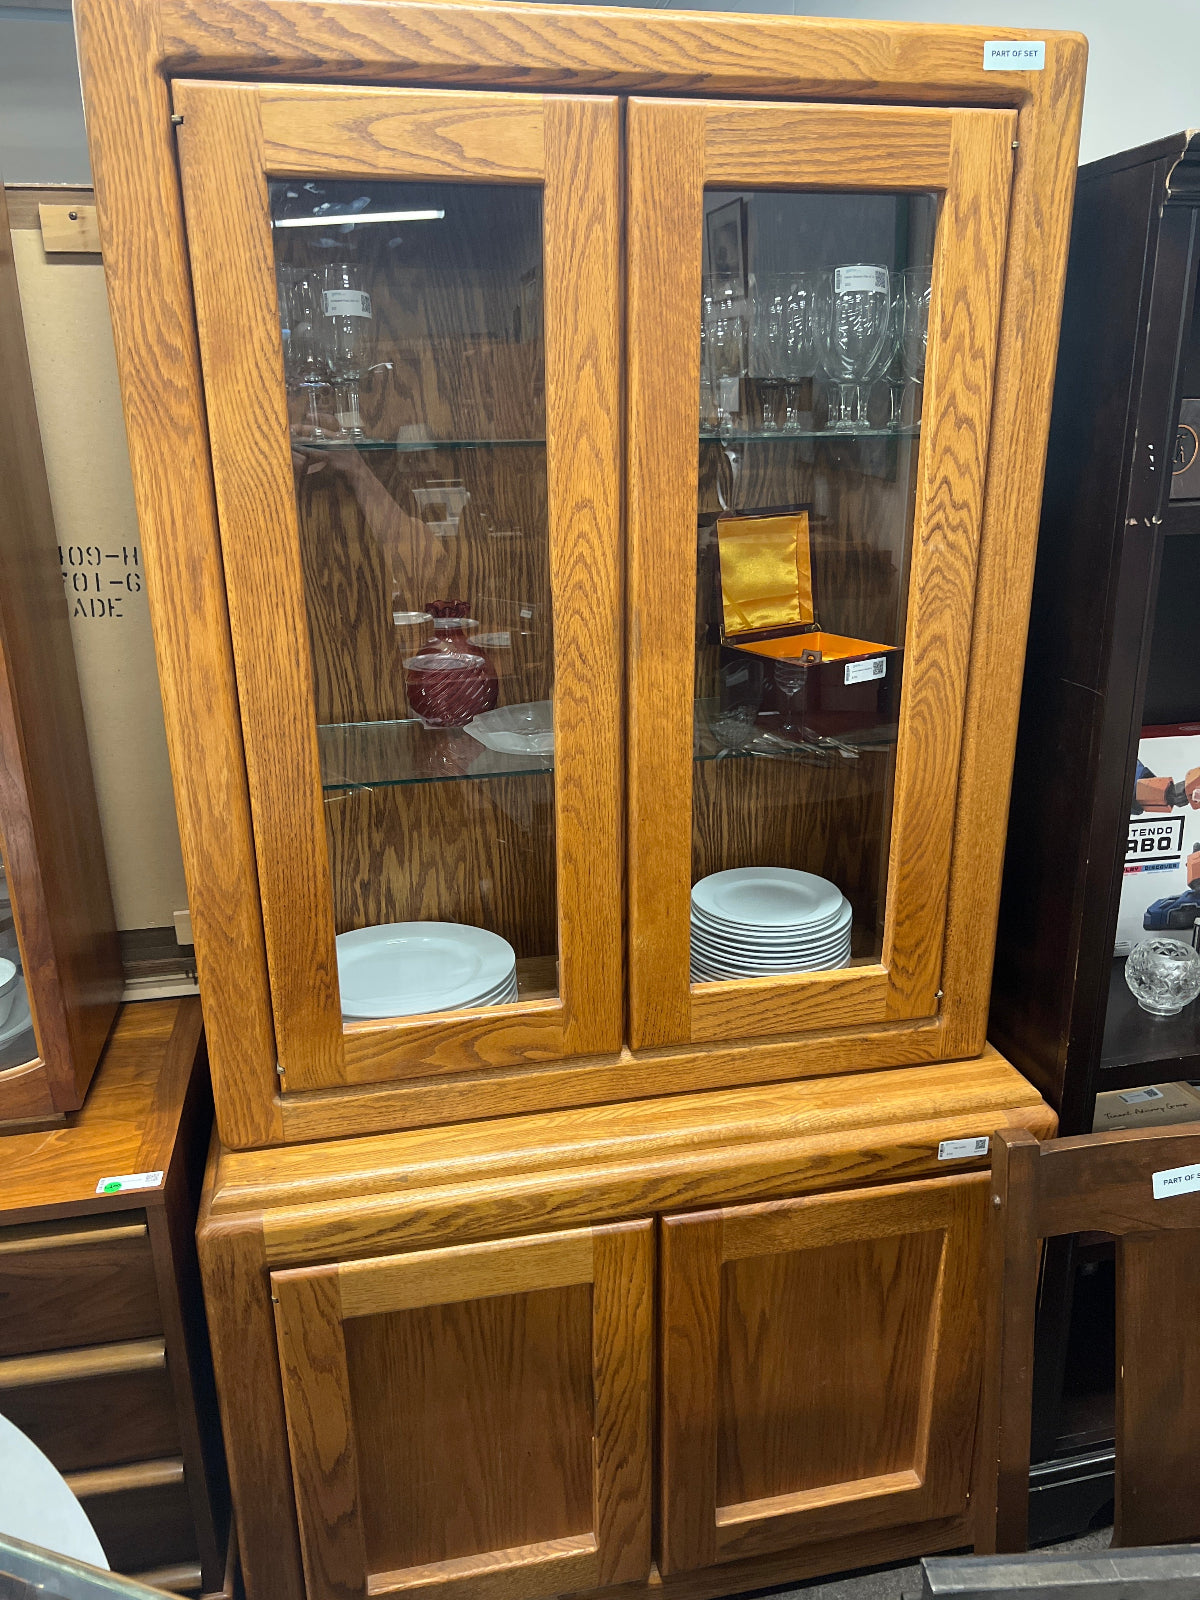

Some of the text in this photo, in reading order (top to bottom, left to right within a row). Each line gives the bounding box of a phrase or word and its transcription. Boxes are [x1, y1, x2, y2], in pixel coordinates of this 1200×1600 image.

[991, 49, 1038, 57] PART OF SET
[1131, 826, 1173, 837] TENDO
[1163, 1176, 1182, 1186] PART
[1184, 1174, 1195, 1182] OF
